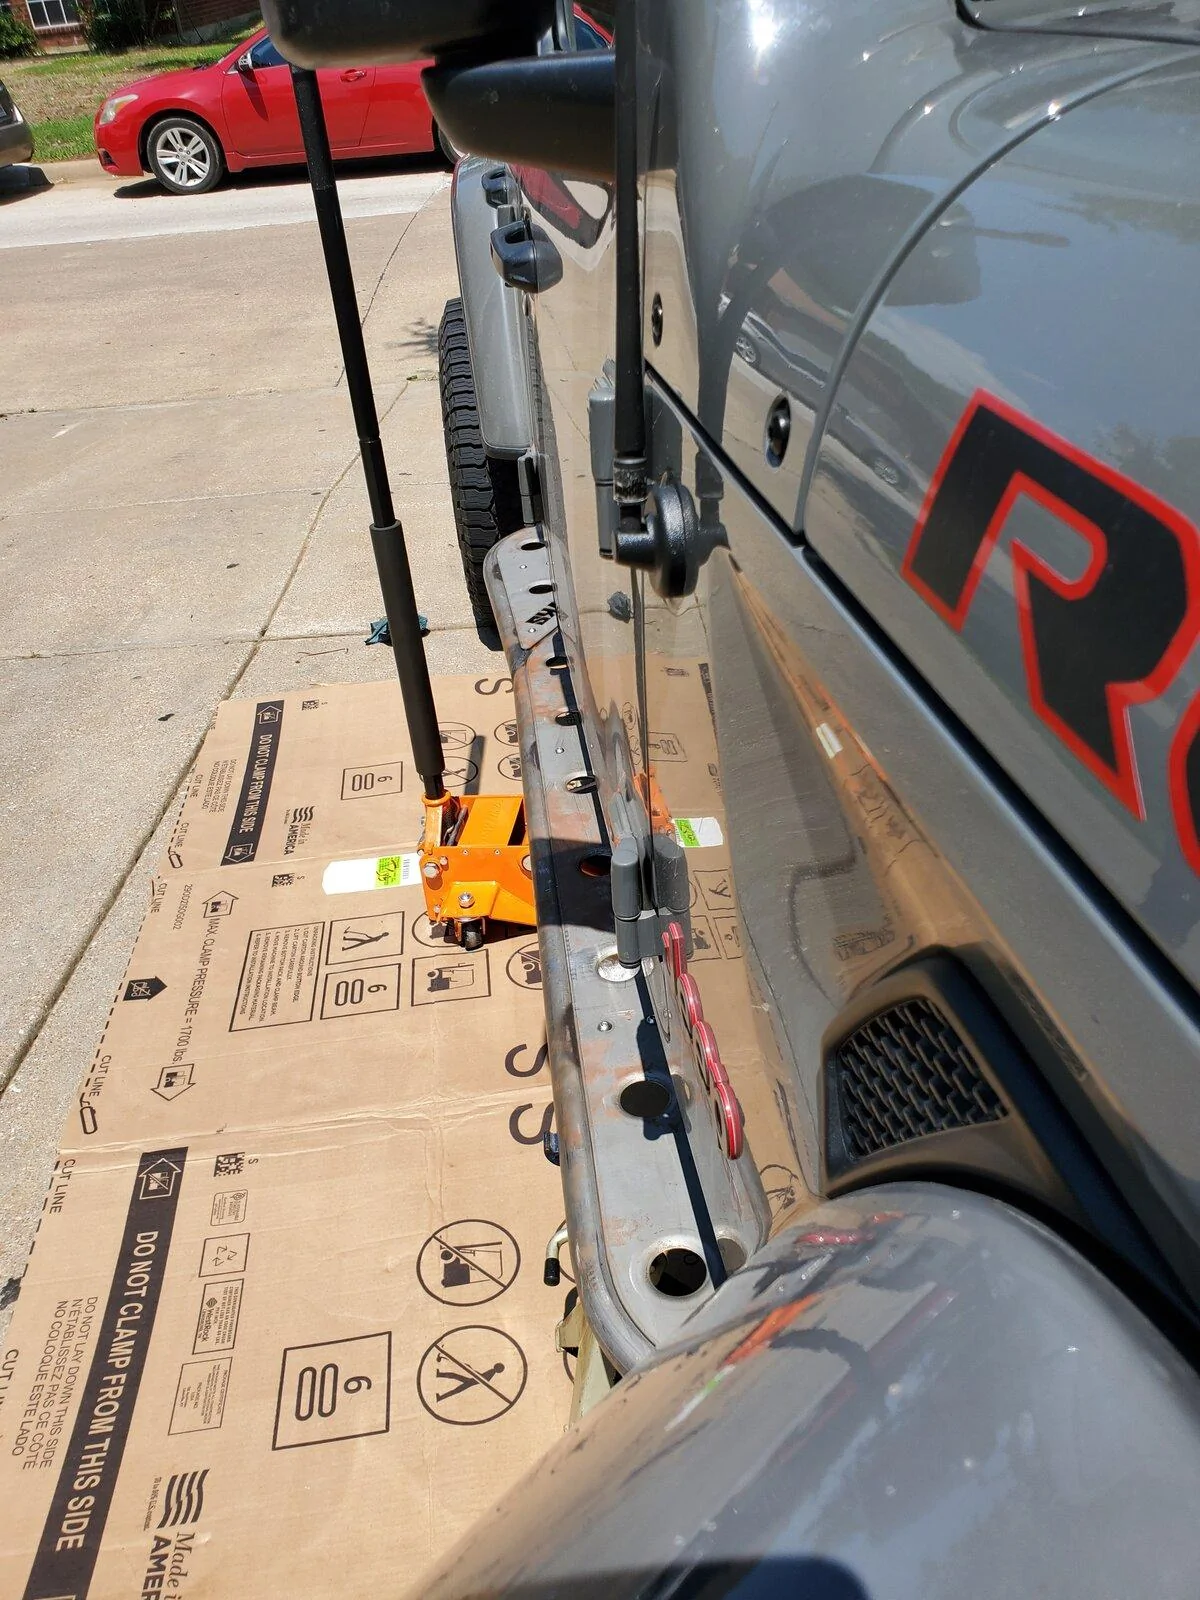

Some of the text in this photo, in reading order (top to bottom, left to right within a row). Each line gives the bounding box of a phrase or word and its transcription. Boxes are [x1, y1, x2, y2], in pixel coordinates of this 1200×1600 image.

[189, 775, 203, 798] CUT LINE
[239, 734, 272, 834] DO NOT CLAMP FROM THIS SIDE
[378, 774, 392, 783] 6
[175, 822, 189, 848] CUT LINE
[284, 825, 300, 855] AMERICA
[299, 823, 311, 838] Made
[151, 883, 168, 914] CUT LINE
[206, 918, 221, 937] MAX.
[199, 939, 215, 966] CLAMP
[263, 936, 271, 952] REMOVE
[270, 947, 278, 964] MACHINE
[248, 957, 258, 984] INSTALLATION
[279, 950, 288, 966] BOTTOM
[307, 948, 316, 976] INSTRUCTIONS
[185, 968, 208, 1016] PRESSURE
[254, 974, 264, 998] PACKAGING
[264, 971, 274, 999] INSTALLATION
[295, 972, 303, 990] BOTTOM
[367, 984, 388, 993] 6
[240, 984, 251, 1015] INSTRUCTIONS
[176, 1025, 193, 1048] 1700
[172, 1048, 187, 1065] lbs.
[89, 1055, 112, 1098] CUT LINE
[248, 1157, 259, 1165] S
[49, 1159, 76, 1215] CUT LINE
[201, 1308, 215, 1342] WestRock
[0, 1349, 19, 1381] CUT
[12, 1301, 69, 1456] NO COLOQUE ESTE LADO
[40, 1297, 98, 1470] DO NOT LAY DOWN THIS SIDE
[55, 1230, 159, 1553] DO NOT CLAMP FROM THIS SIDE
[343, 1375, 372, 1394] 6
[43, 1384, 61, 1409] PAS
[36, 1411, 51, 1430] CE
[167, 1532, 196, 1589] Made
